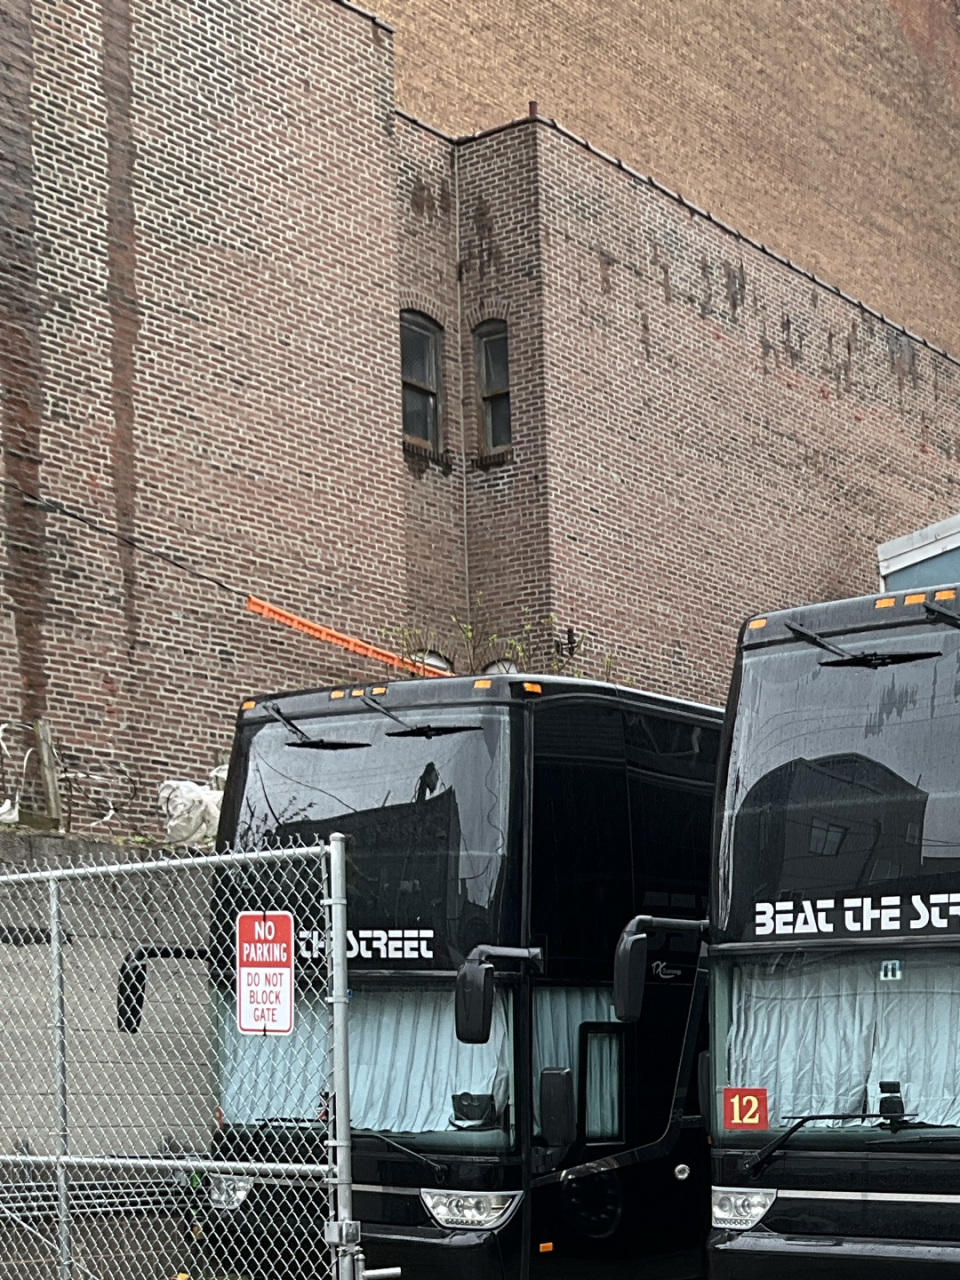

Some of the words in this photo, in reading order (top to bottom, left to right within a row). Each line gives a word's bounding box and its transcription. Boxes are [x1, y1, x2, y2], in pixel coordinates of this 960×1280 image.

[755, 899, 835, 936] BEAT
[844, 895, 901, 932] THE
[254, 920, 276, 941] NO
[243, 943, 288, 963] PARKING
[346, 929, 434, 959] STREET
[246, 972, 261, 987] DO
[264, 972, 284, 987] NOT
[249, 989, 282, 1005] BLOCK
[253, 1007, 278, 1023] GATE
[730, 1094, 760, 1124] 12
